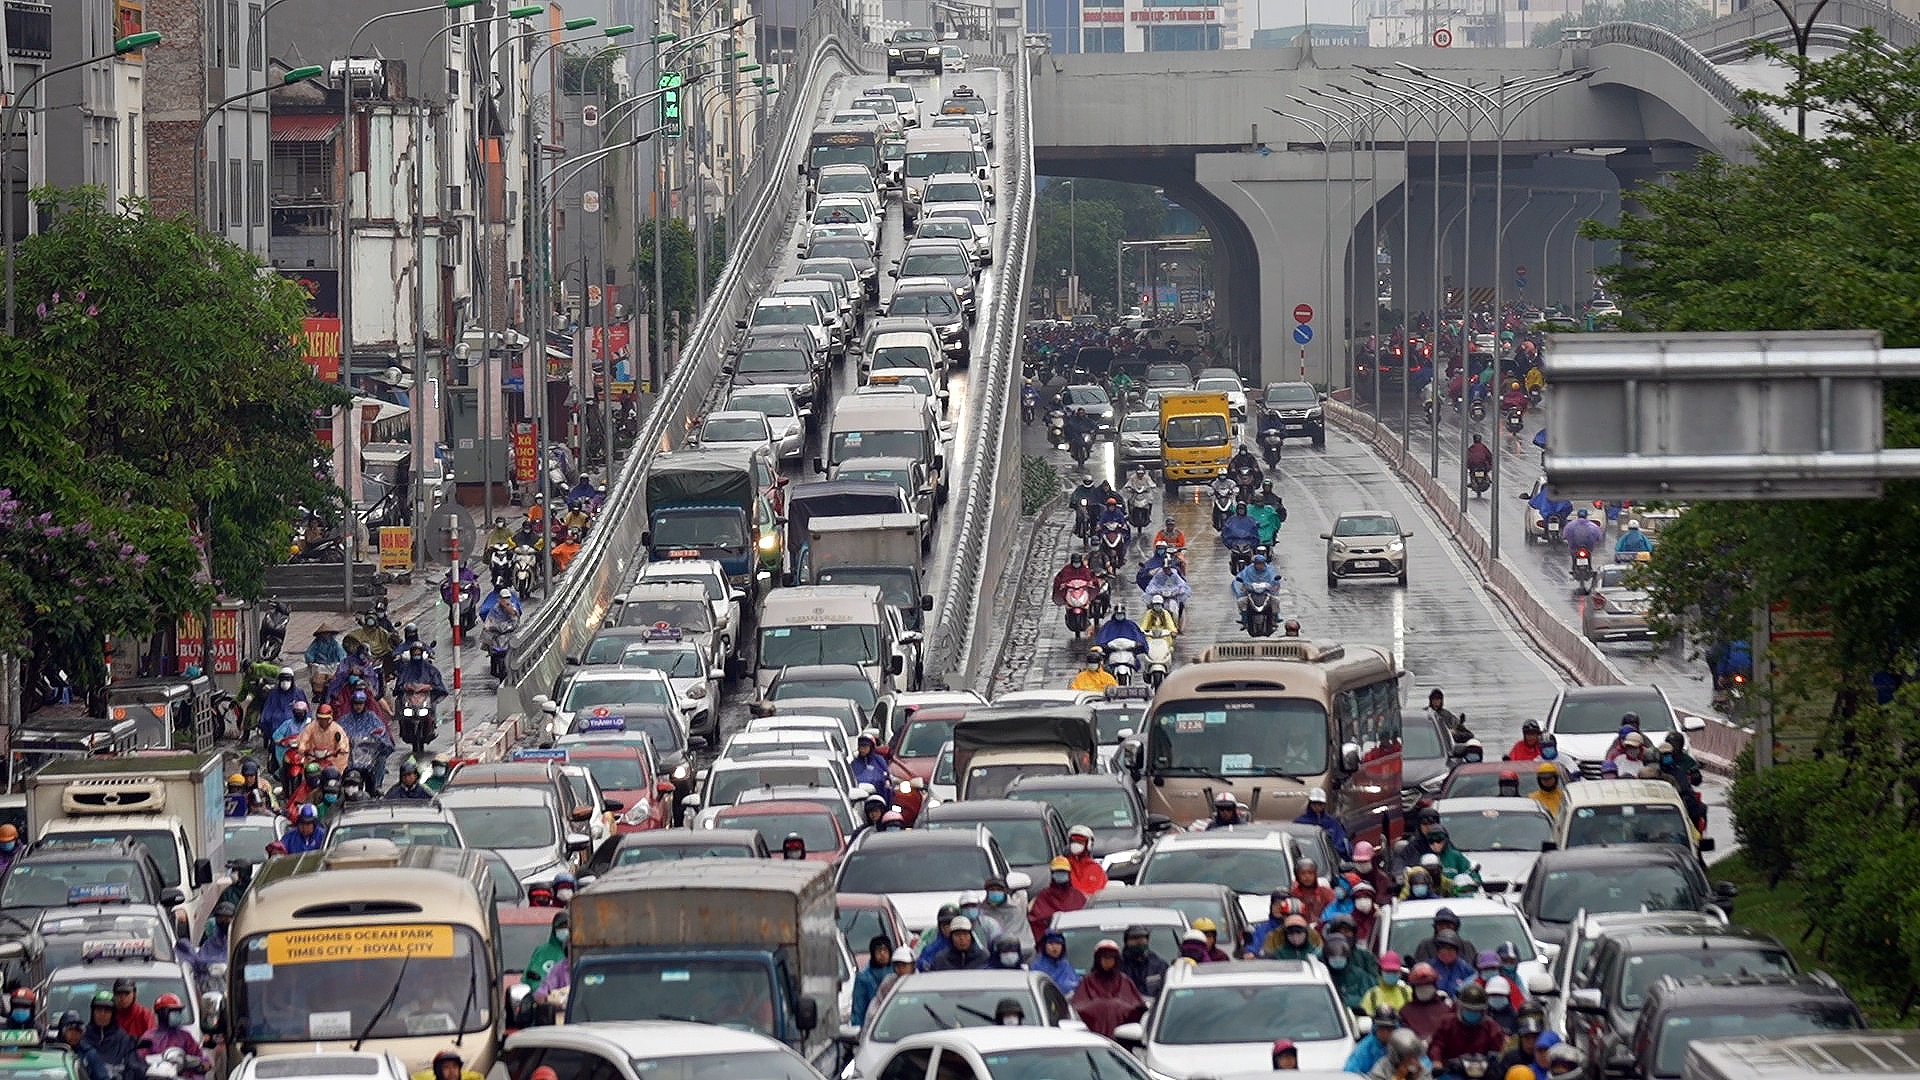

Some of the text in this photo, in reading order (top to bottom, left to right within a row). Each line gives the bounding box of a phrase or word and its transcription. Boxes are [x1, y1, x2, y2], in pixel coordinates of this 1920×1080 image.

[285, 930, 433, 944] VINHOMES OCEAN PARK
[287, 947, 324, 958] TIMES
[326, 945, 353, 955] CITY
[363, 943, 404, 954] ROYAL
[407, 942, 433, 952] CITY
